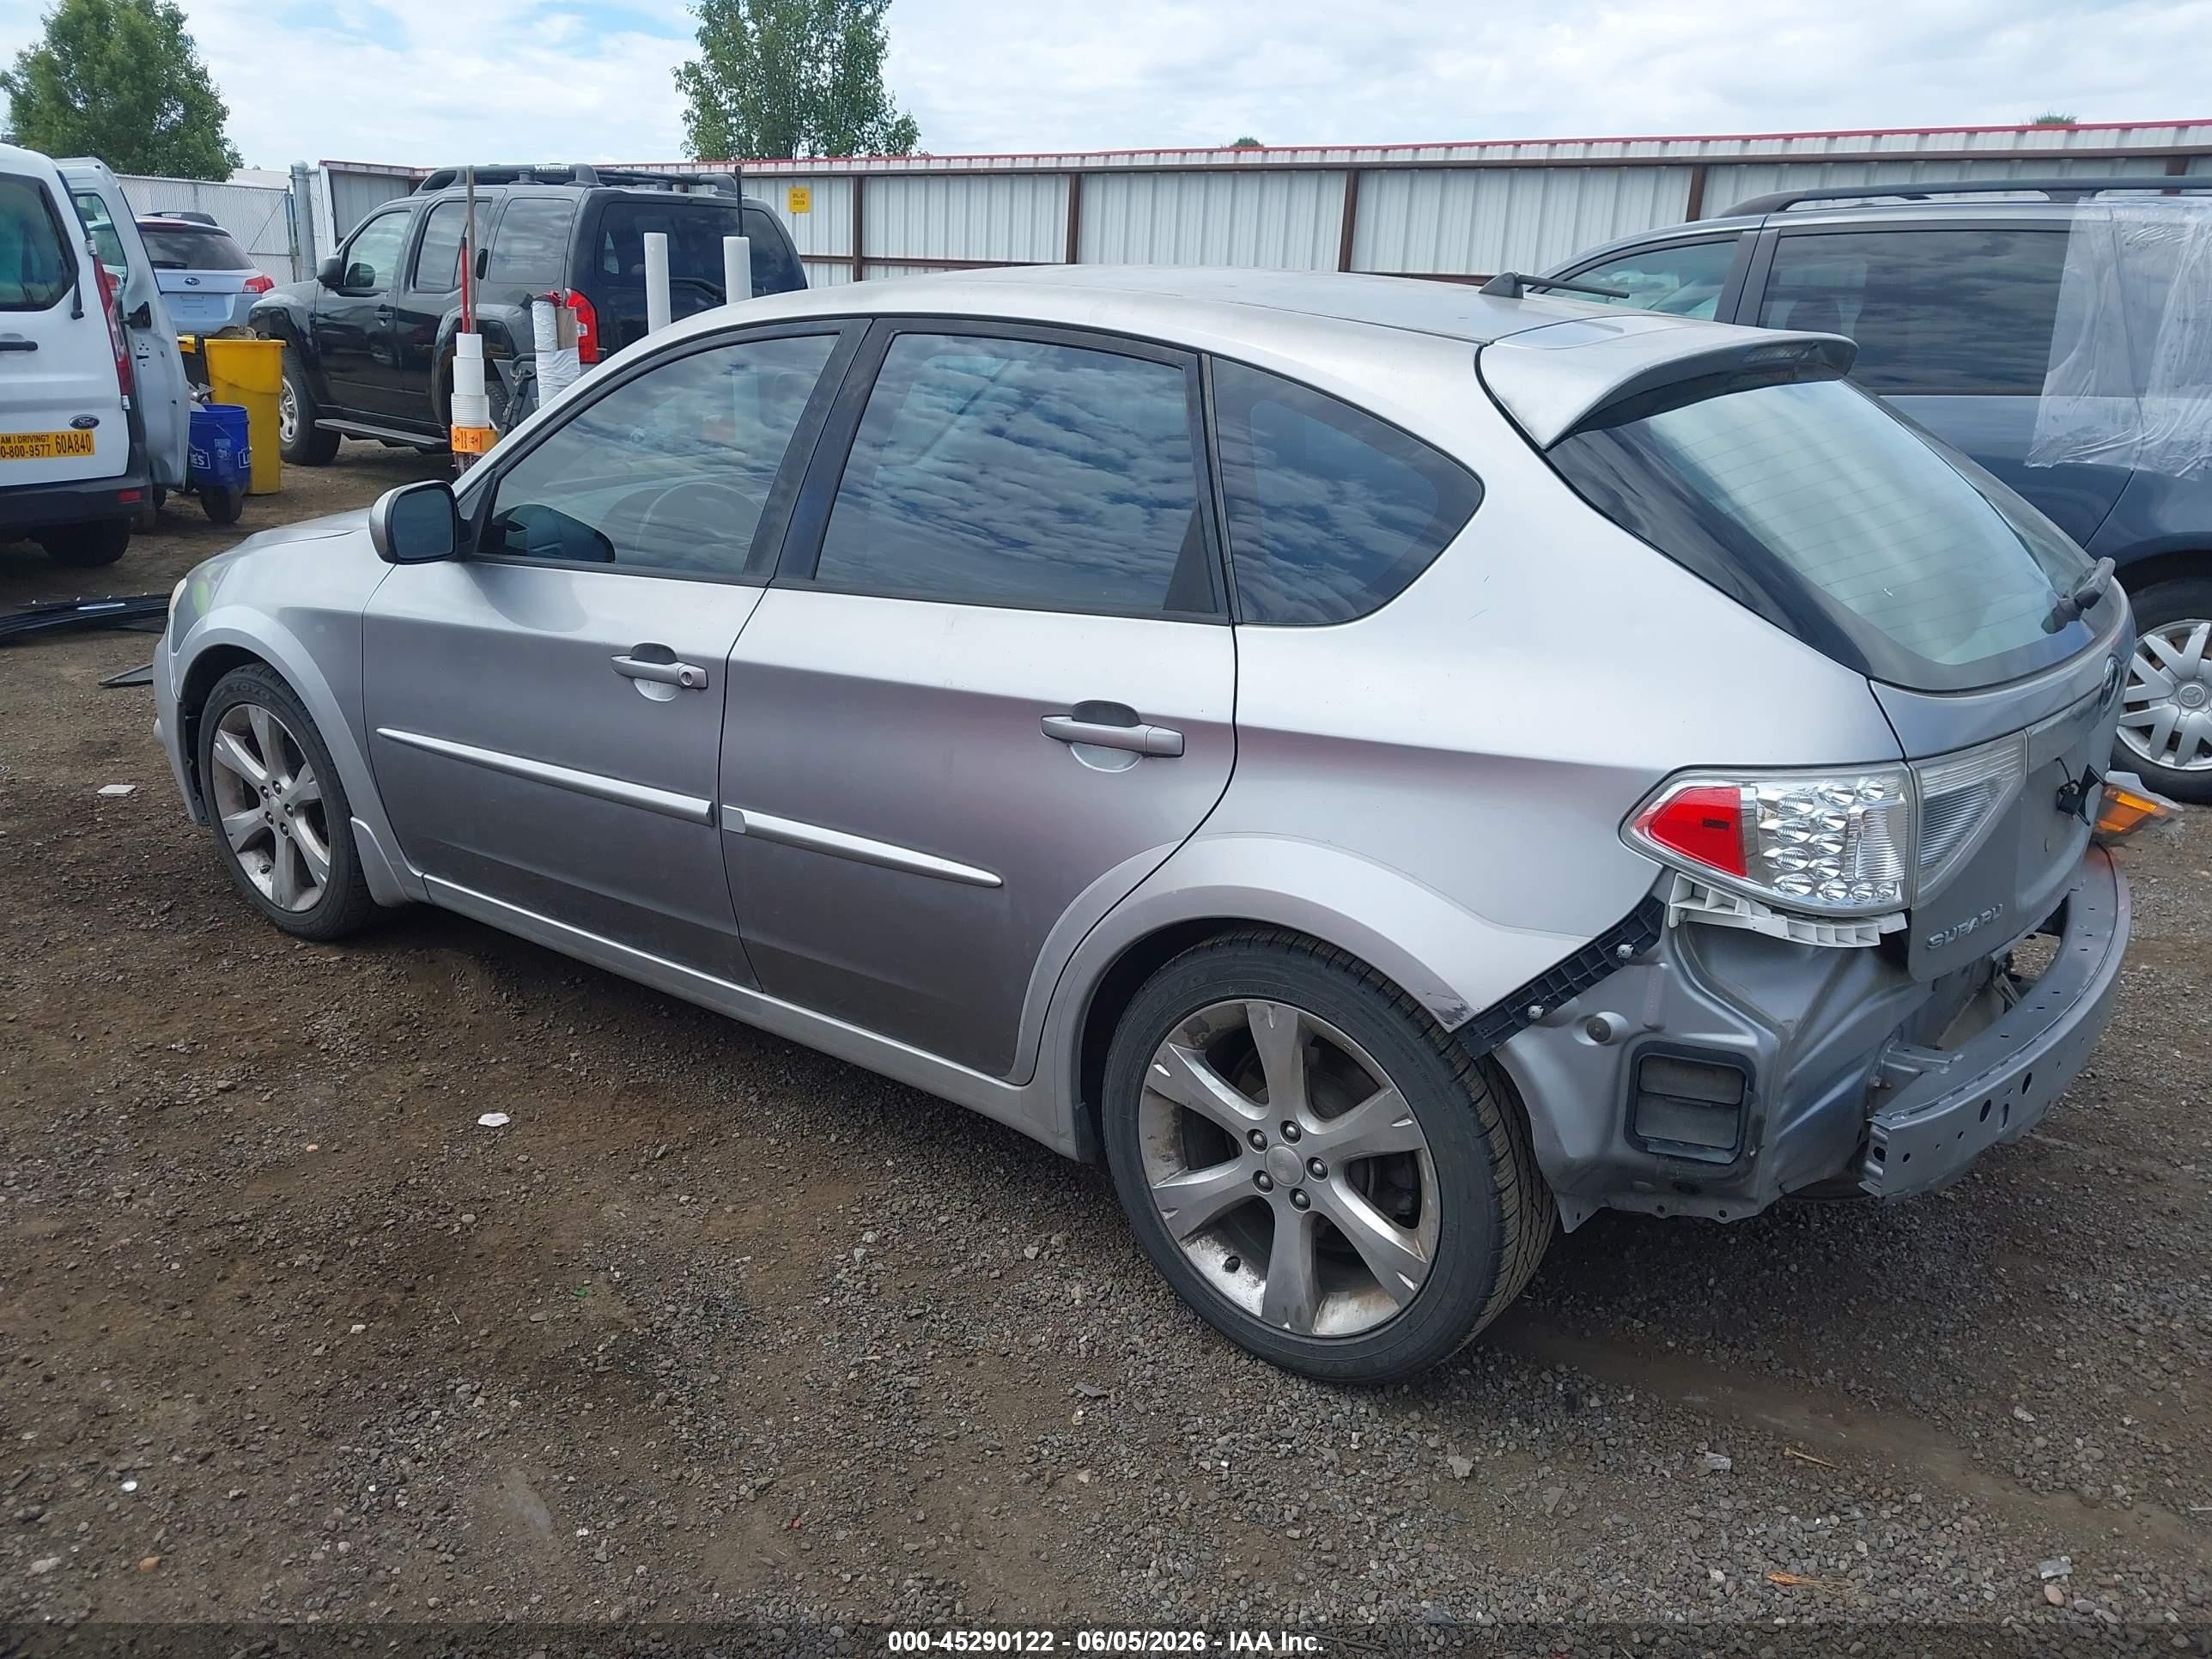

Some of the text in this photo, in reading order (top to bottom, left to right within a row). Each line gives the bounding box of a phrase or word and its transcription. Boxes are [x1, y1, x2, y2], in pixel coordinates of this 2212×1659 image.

[1, 435, 11, 445] AM
[18, 434, 50, 444] DRIVING?
[55, 433, 91, 454] 60A840
[1926, 903, 2002, 949] SUBARU
